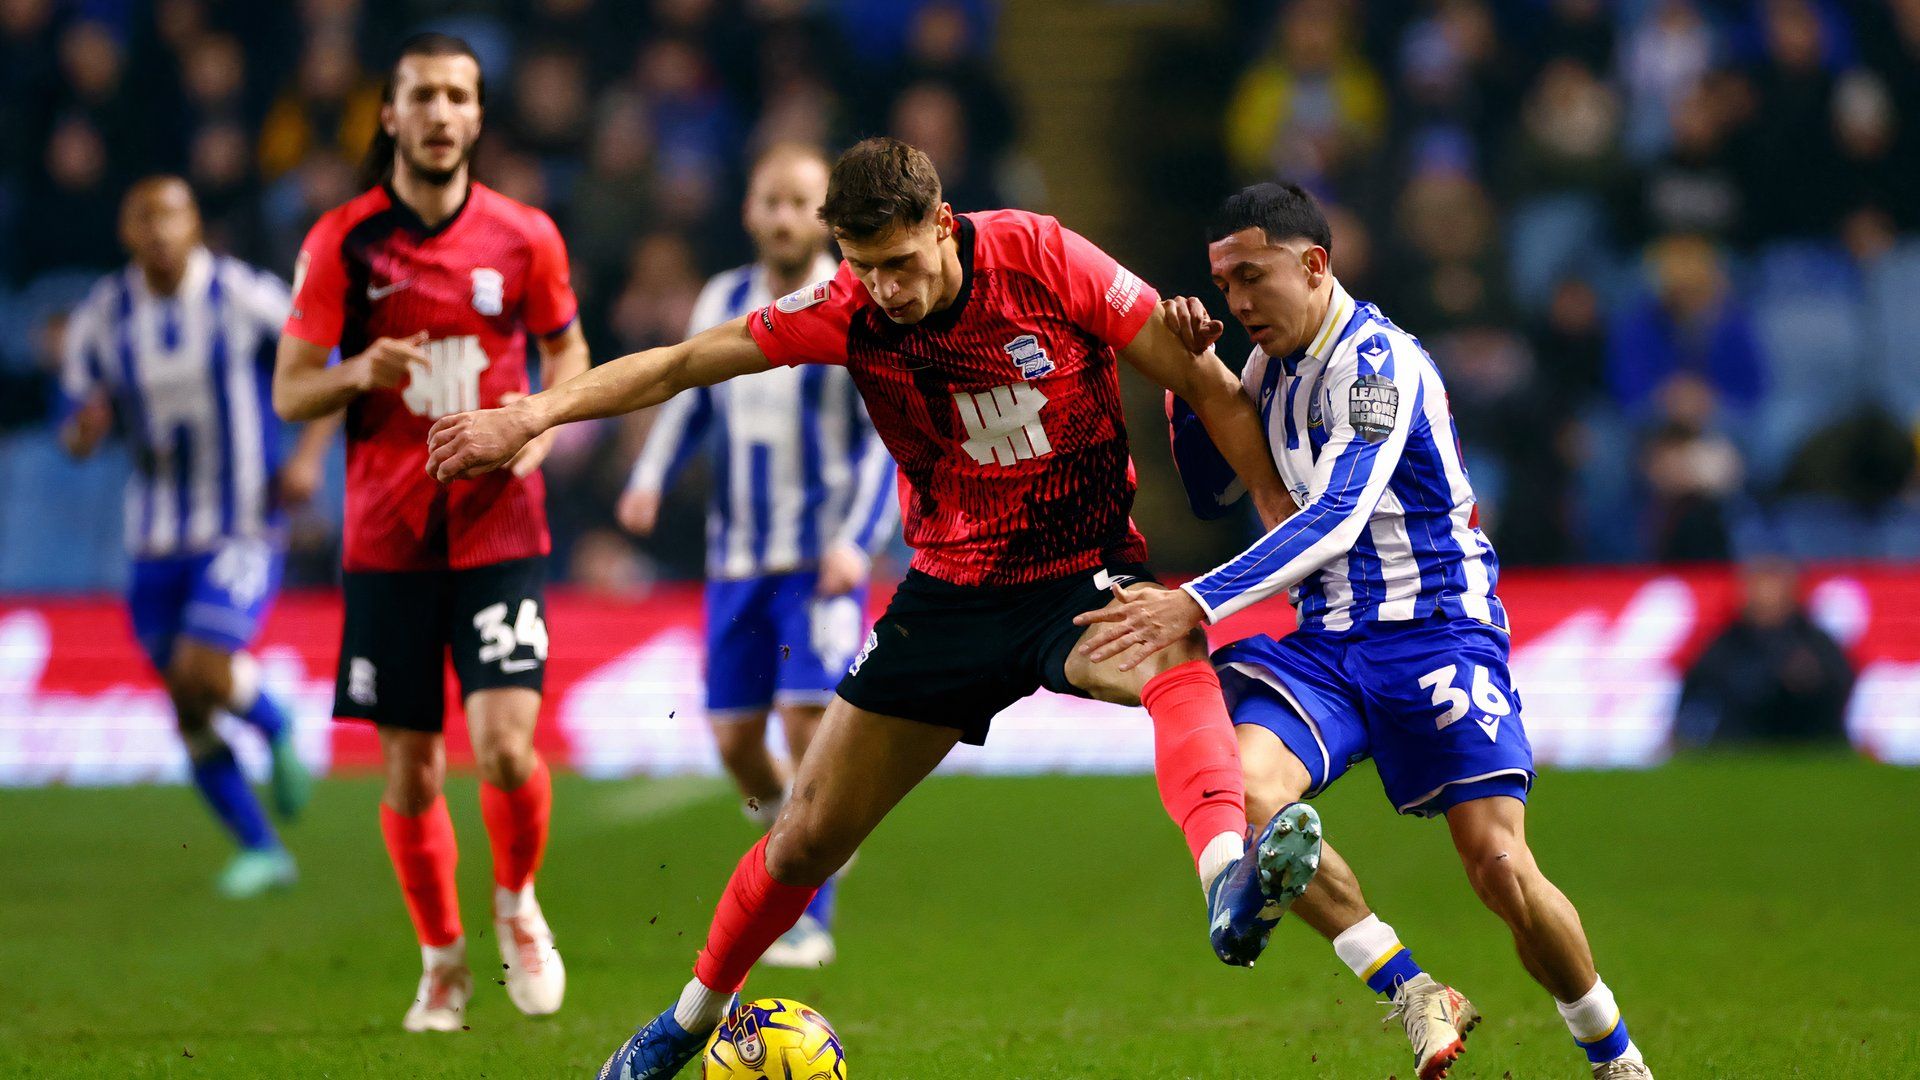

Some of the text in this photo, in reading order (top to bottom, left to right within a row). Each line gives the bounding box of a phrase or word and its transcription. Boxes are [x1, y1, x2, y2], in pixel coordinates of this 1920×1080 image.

[1111, 287, 1128, 309] CITY
[1351, 387, 1398, 406] LEAVE
[1351, 401, 1397, 418] NO ONE
[1350, 412, 1395, 428] BEHIND
[473, 599, 549, 664] 34
[1418, 664, 1511, 730] 36
